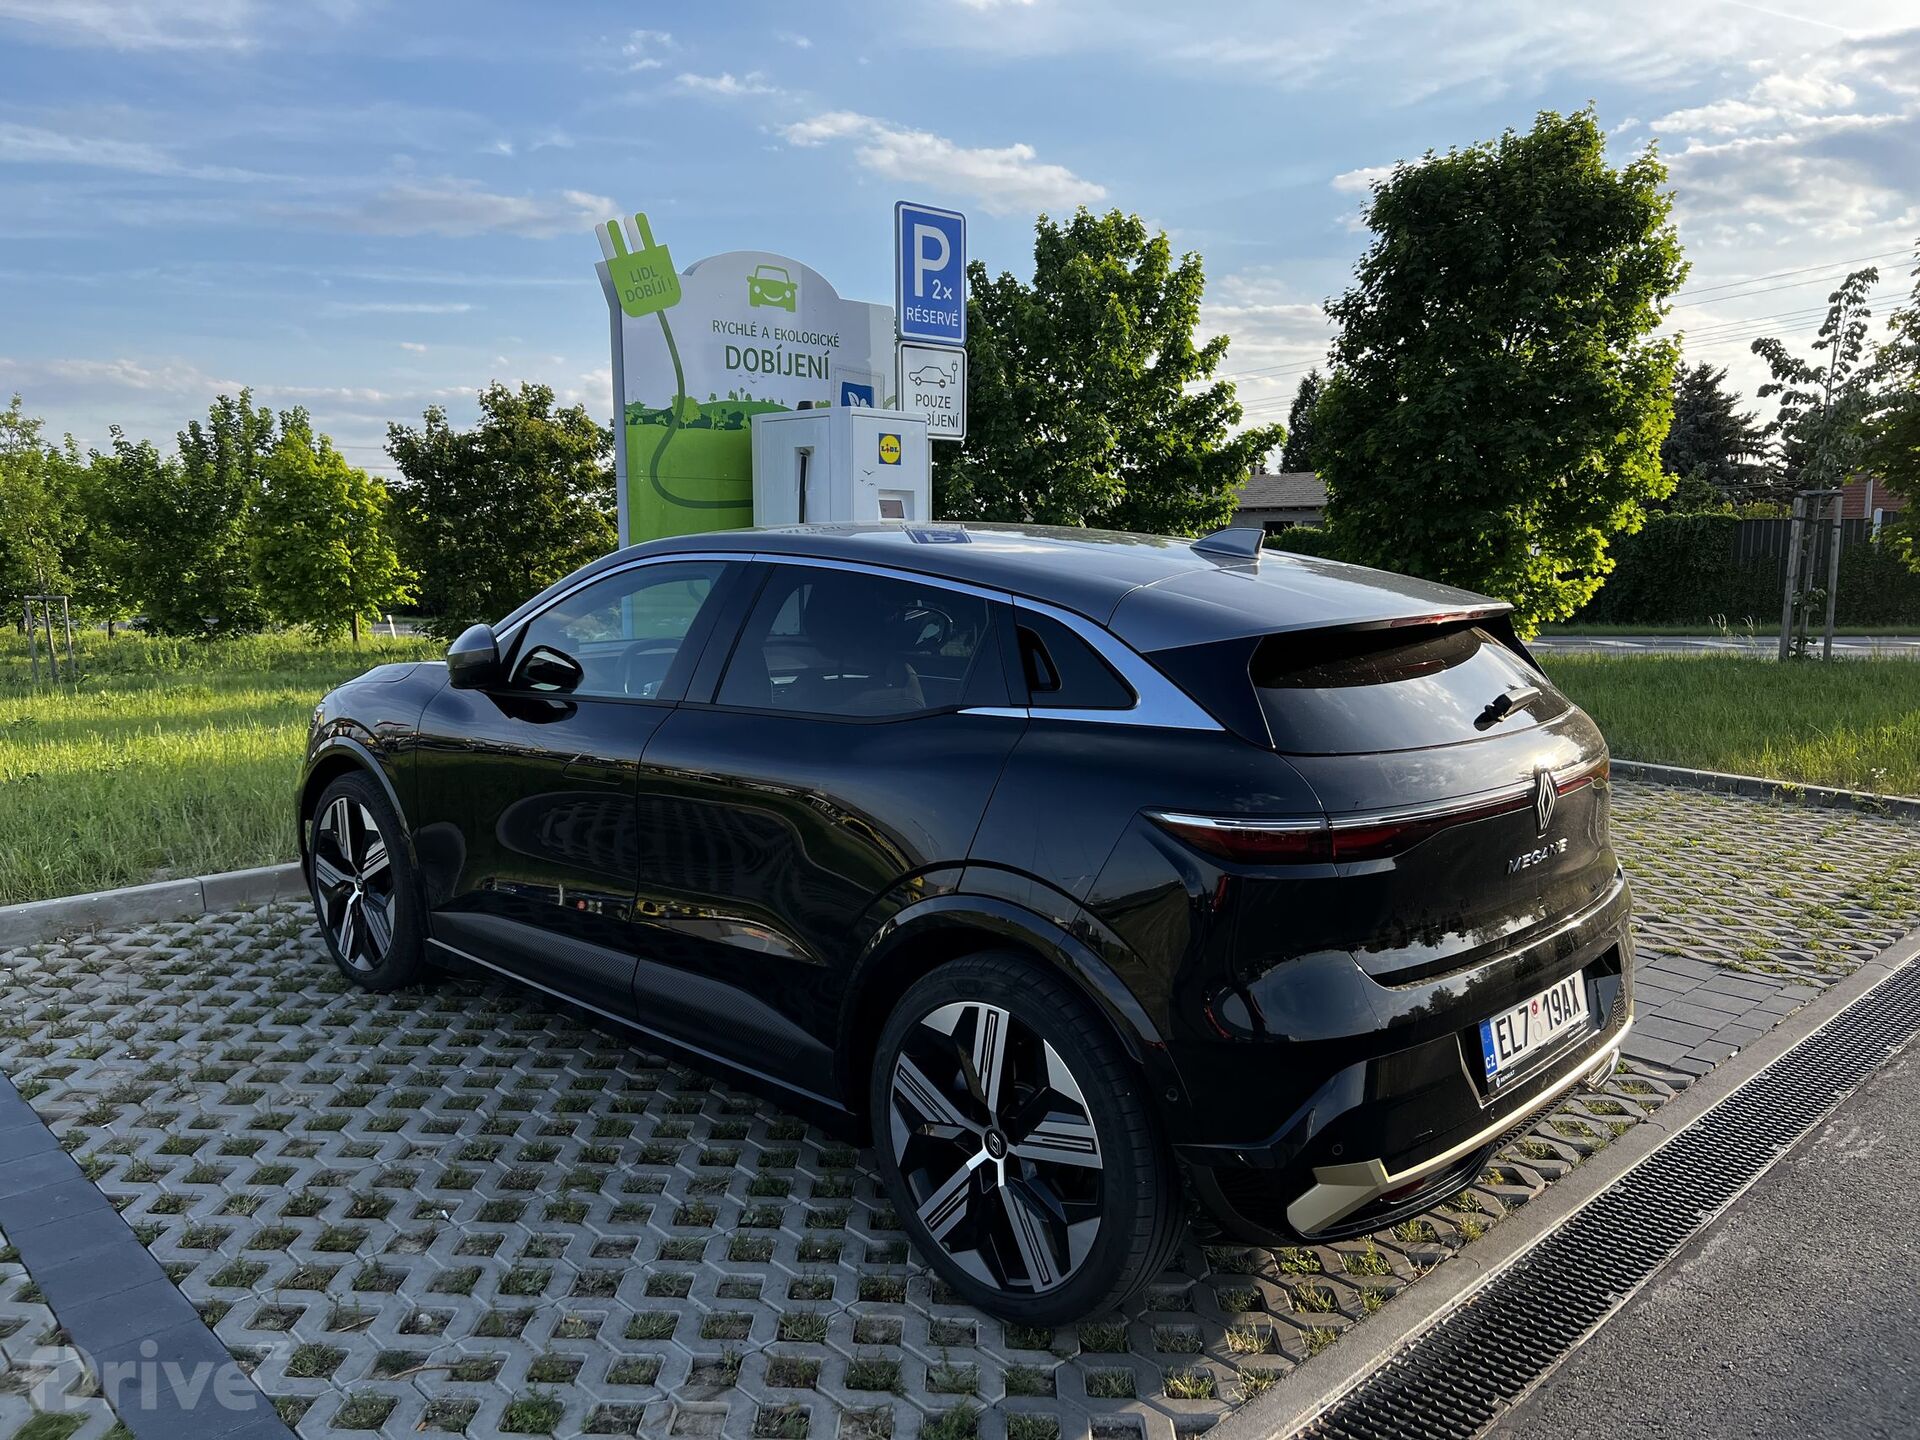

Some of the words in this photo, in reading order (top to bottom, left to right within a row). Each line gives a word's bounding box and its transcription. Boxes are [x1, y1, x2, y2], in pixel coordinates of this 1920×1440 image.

[914, 223, 950, 298] P
[629, 264, 659, 284] LIDL
[906, 304, 959, 327] RÉSERVÉ
[712, 319, 757, 338] RYCHLÉ
[761, 326, 770, 339] A
[774, 327, 840, 348] EKOLOGICKÉ
[725, 343, 830, 380] DOBÍJENÍ
[915, 393, 952, 410] POUZE
[927, 412, 960, 429] BÍJENÍ
[1506, 838, 1568, 875] MEGANE
[1495, 1004, 1530, 1061] EL7
[1542, 976, 1581, 1032] 19AX
[1485, 1054, 1496, 1069] CZ
